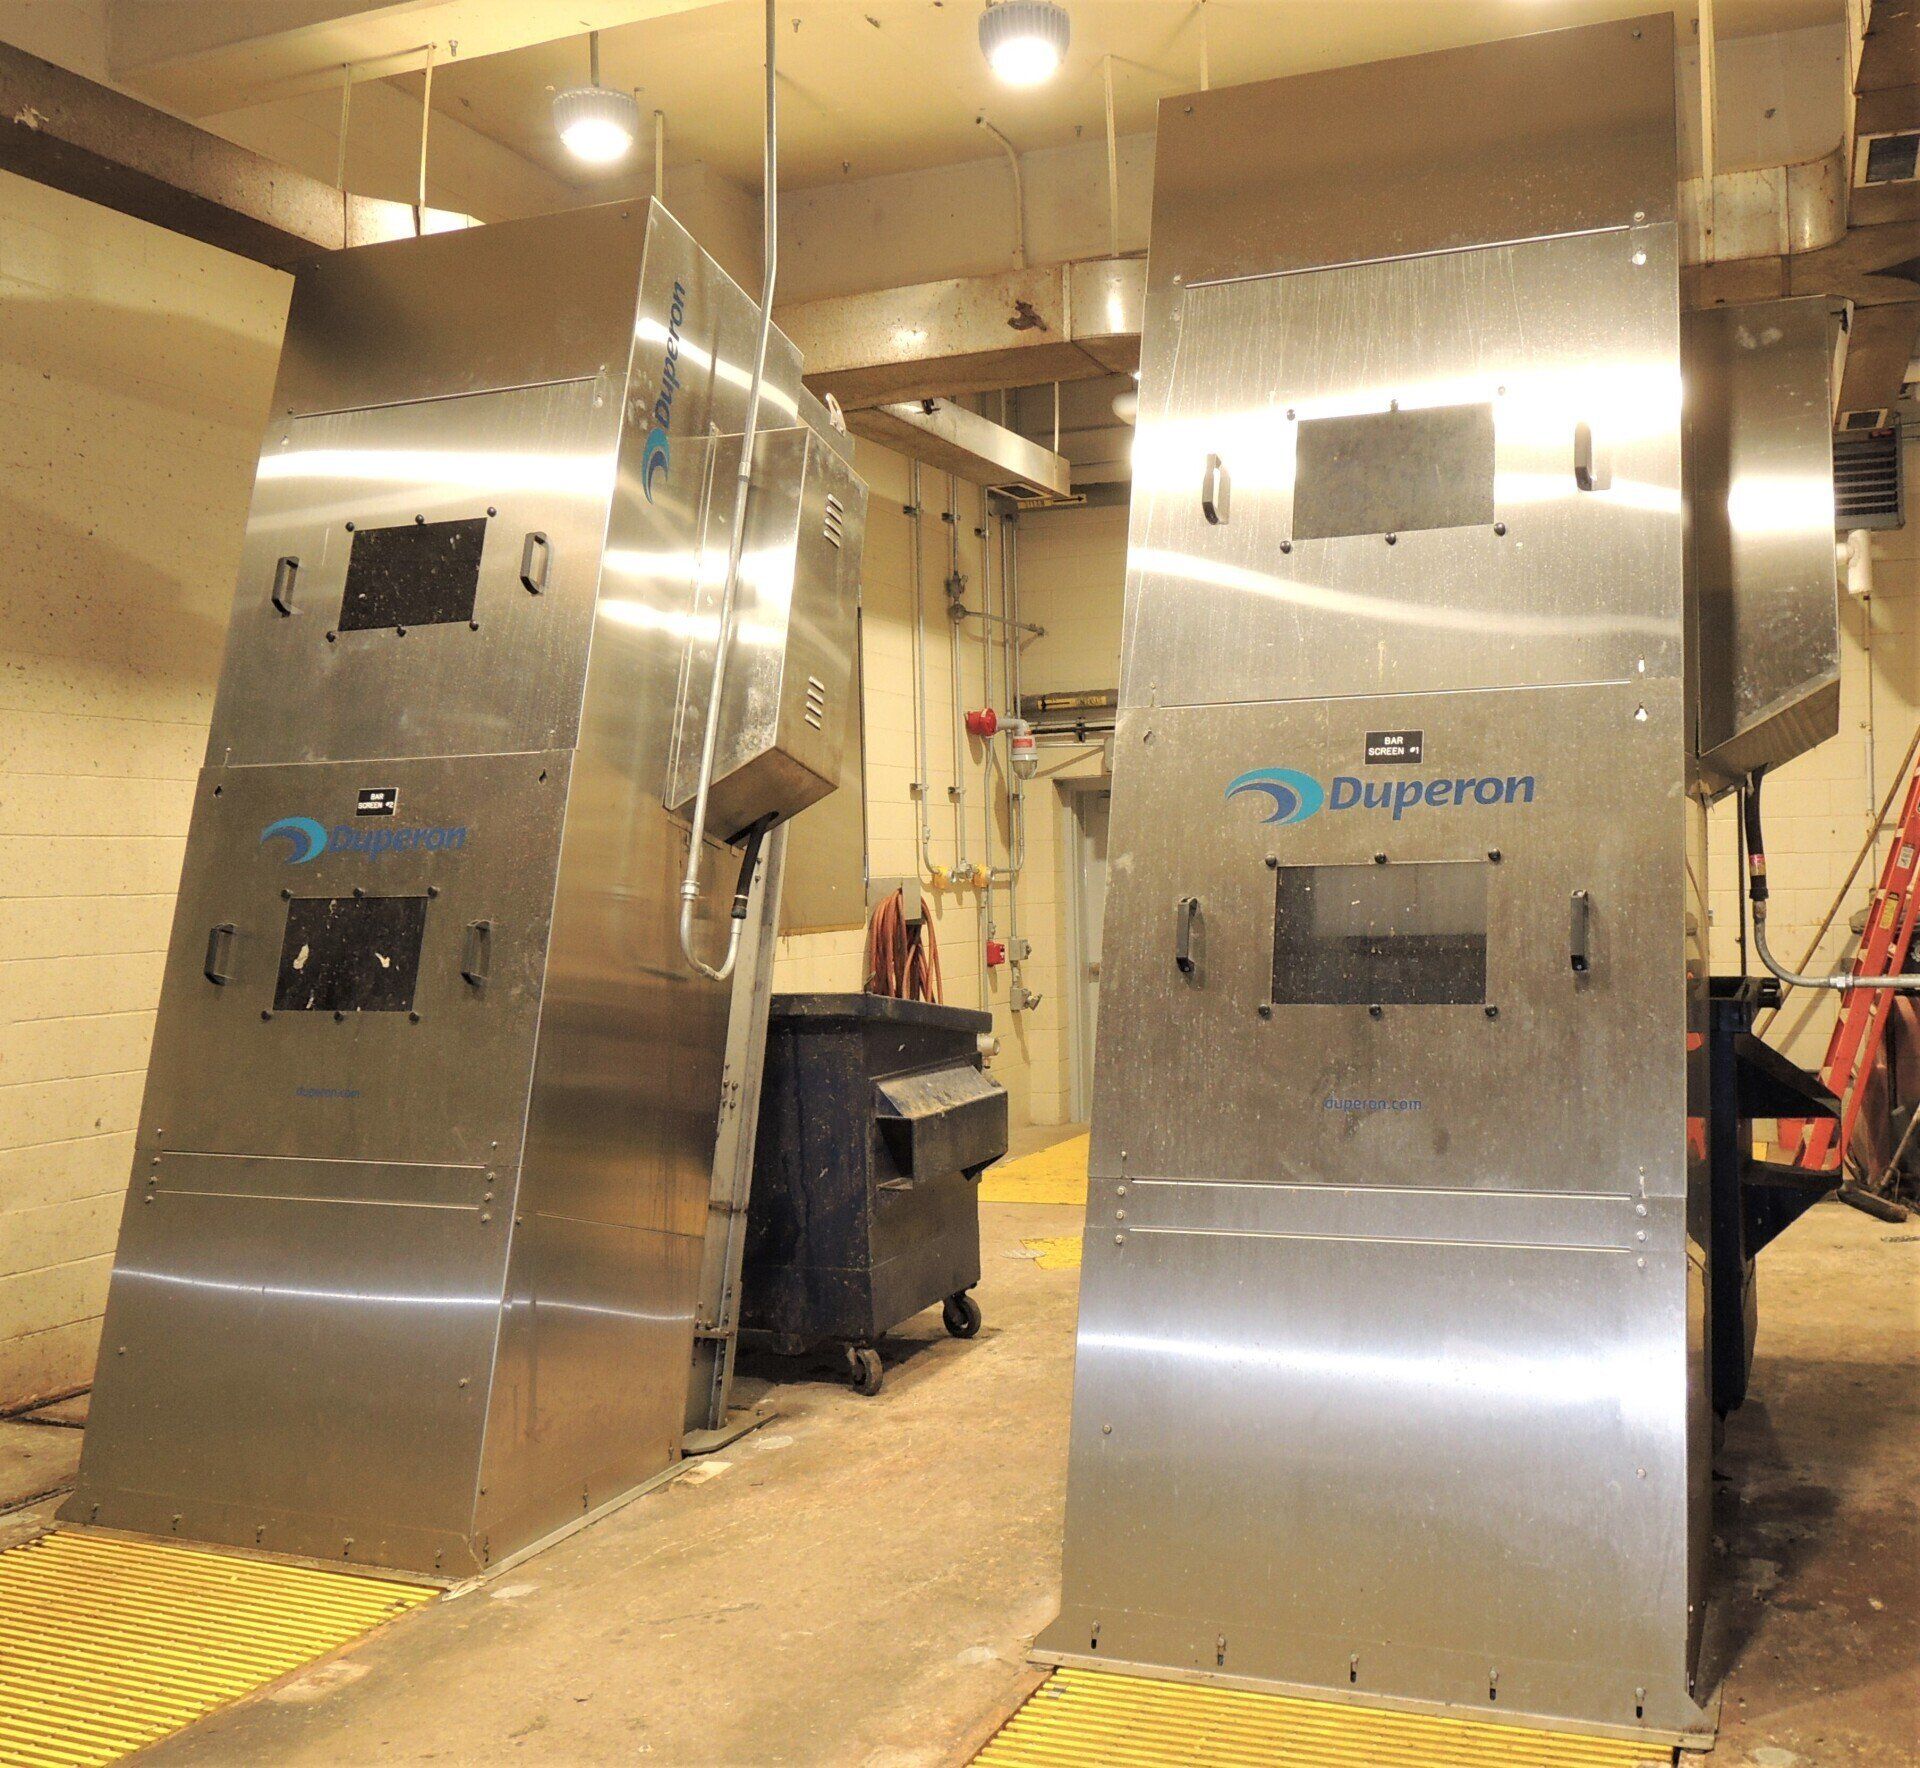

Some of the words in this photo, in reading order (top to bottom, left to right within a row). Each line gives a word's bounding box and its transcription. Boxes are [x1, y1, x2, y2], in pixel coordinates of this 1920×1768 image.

[654, 280, 686, 430] Duperon
[1384, 736, 1404, 745] BAR
[1368, 747, 1405, 756] SCREEN
[370, 793, 385, 801] BAR
[1329, 775, 1535, 821] Duperon
[358, 801, 383, 810] SCREEN
[329, 824, 469, 862] Duperon
[1323, 1095, 1422, 1112] duperon.com
